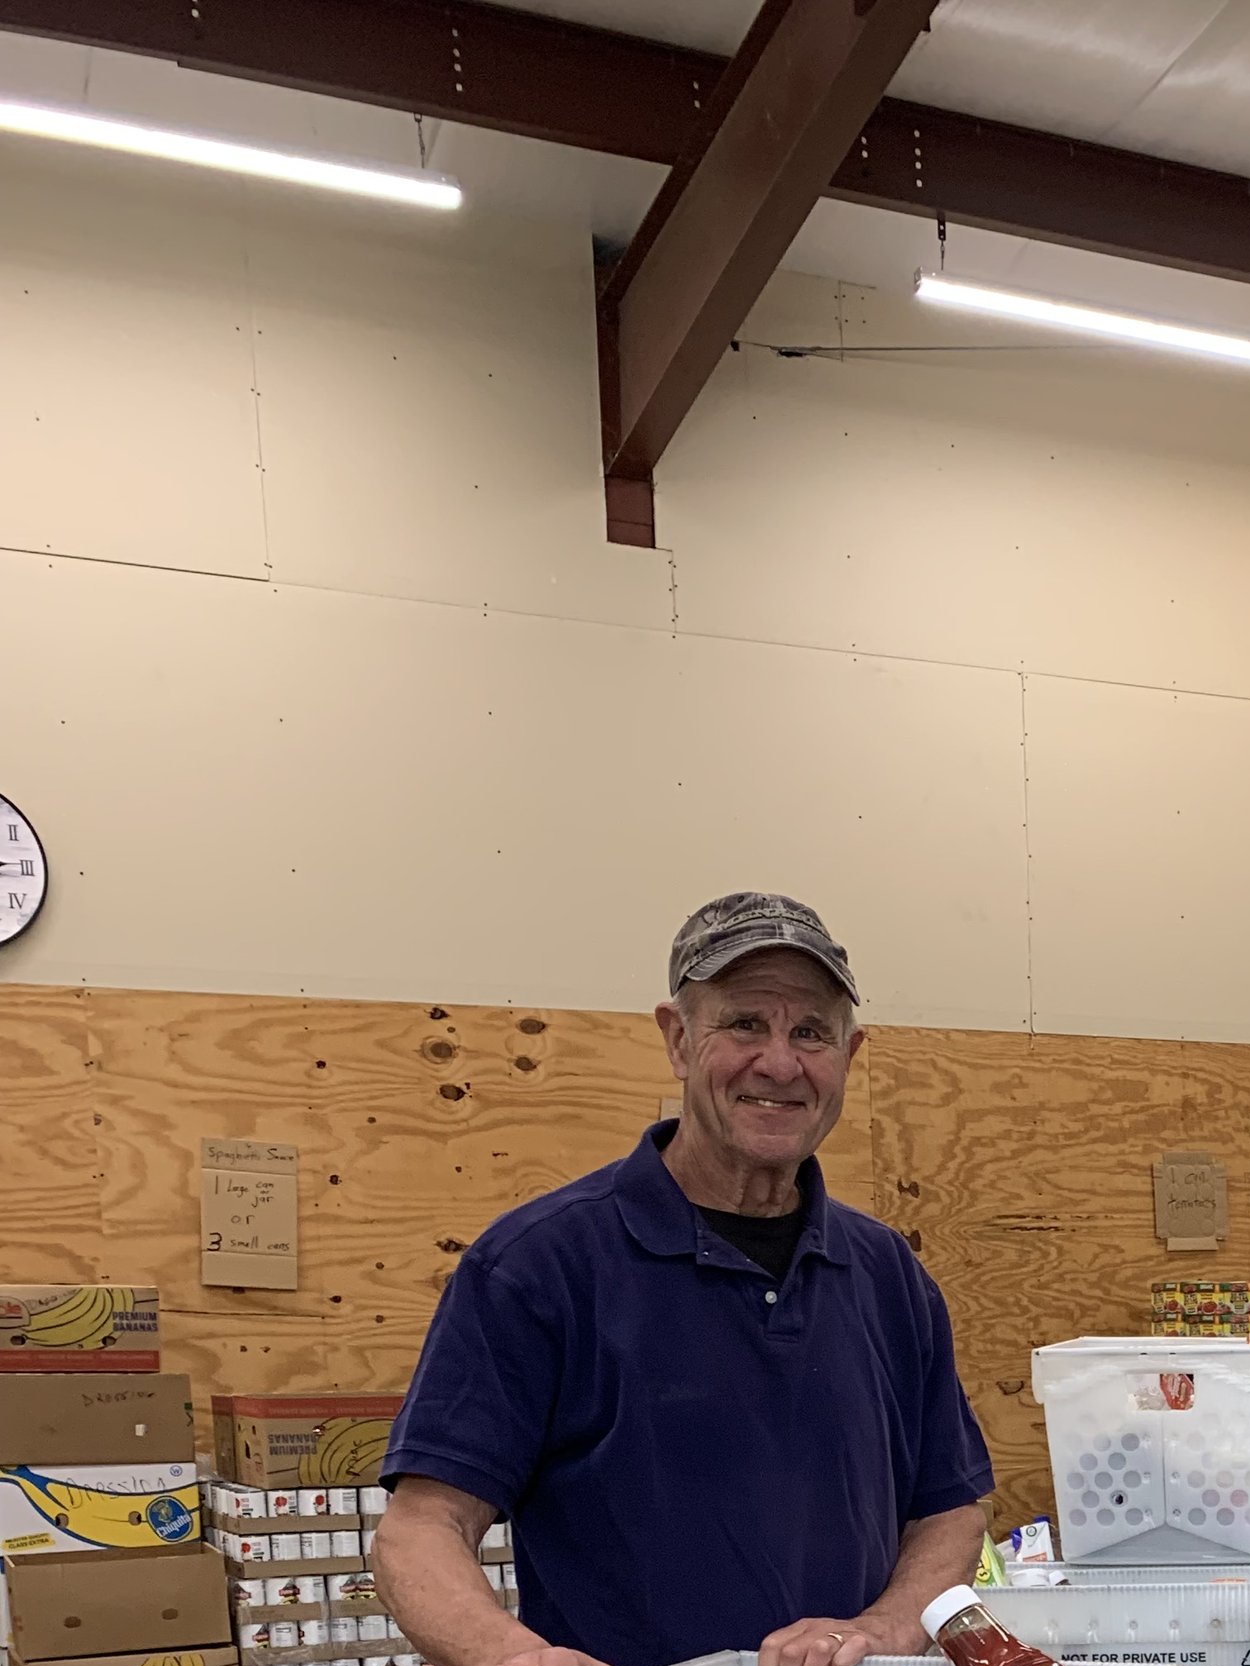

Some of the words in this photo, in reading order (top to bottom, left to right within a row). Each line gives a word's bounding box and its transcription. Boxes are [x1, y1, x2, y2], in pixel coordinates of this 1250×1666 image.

[8, 892, 27, 909] IV
[251, 1196, 274, 1208] jar
[231, 1215, 256, 1225] or
[207, 1232, 222, 1251] 3
[112, 1312, 157, 1320] PREMIUM
[113, 1322, 158, 1332] BANANAS
[156, 1513, 191, 1537] Chiquita
[1092, 1654, 1119, 1663] FOR
[1122, 1653, 1176, 1663] PRIVATE
[1180, 1652, 1206, 1663] USE
